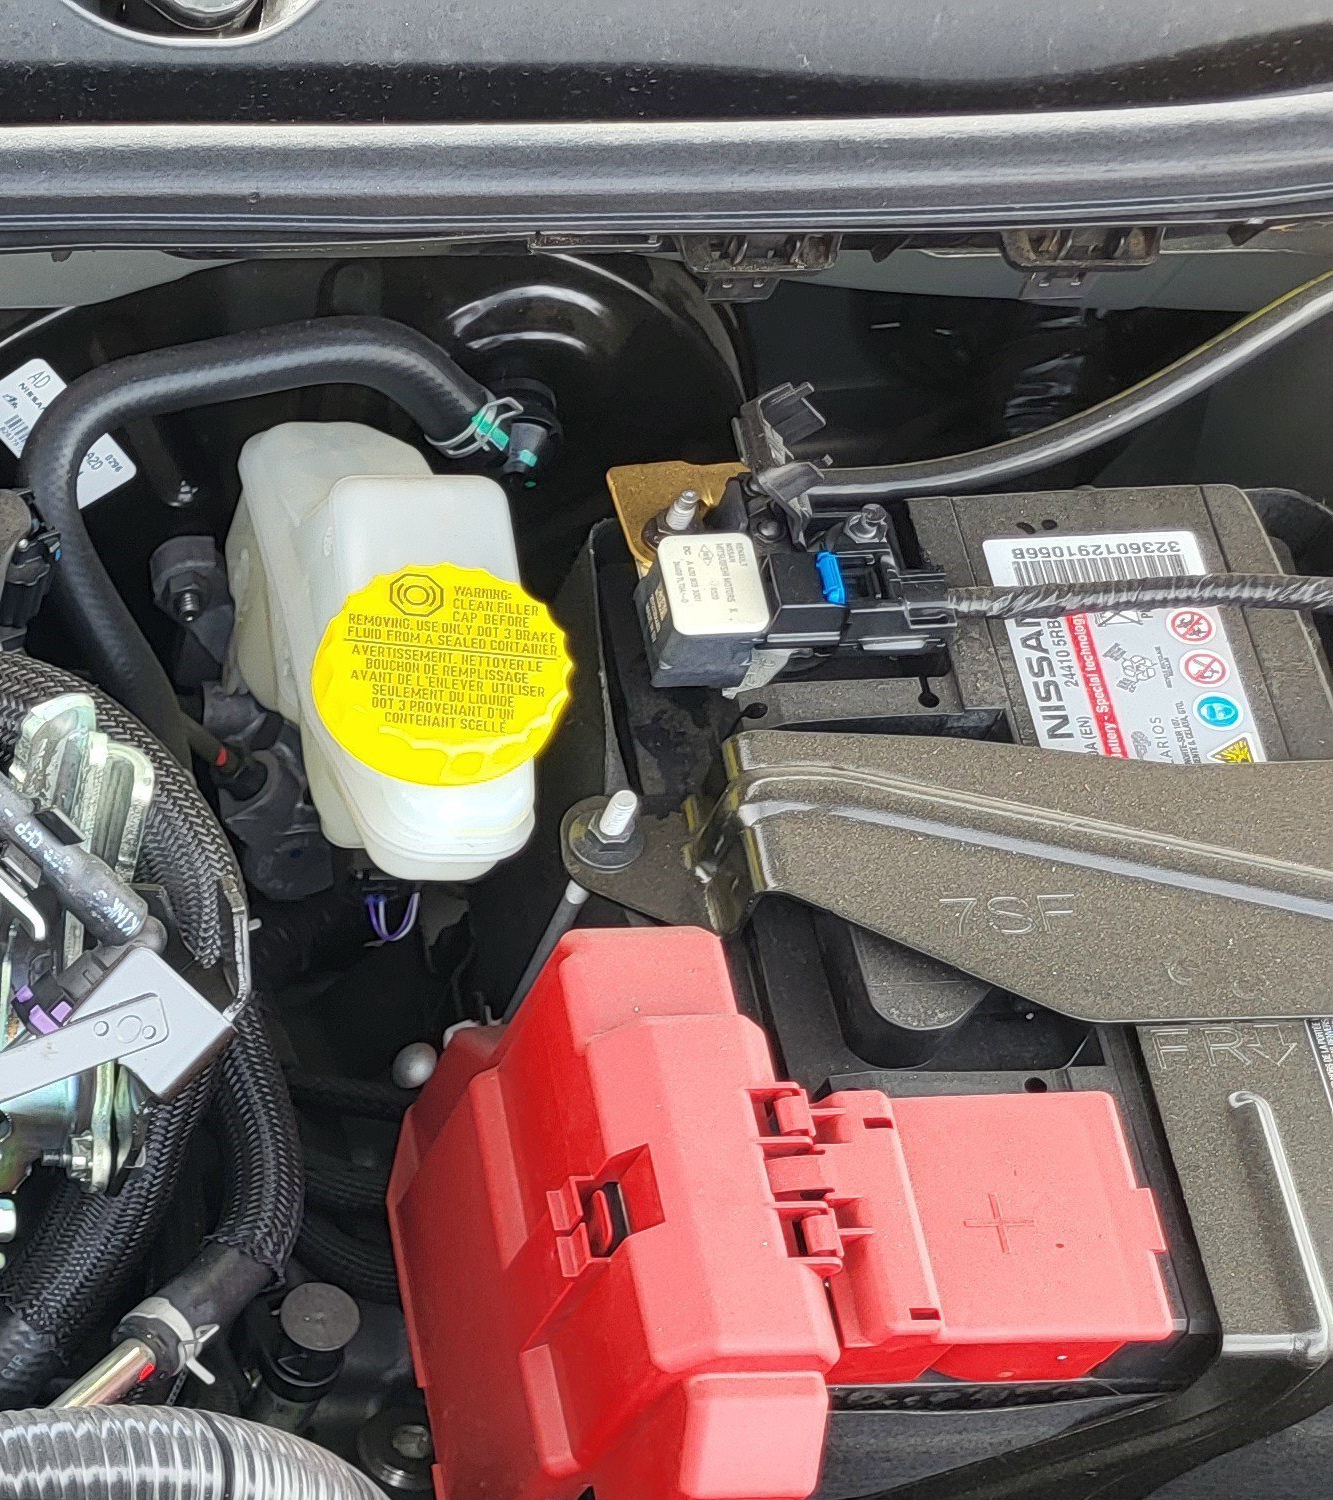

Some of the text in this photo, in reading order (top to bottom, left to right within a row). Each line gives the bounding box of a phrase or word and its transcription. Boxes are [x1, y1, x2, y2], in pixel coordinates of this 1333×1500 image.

[27, 371, 50, 389] AD
[19, 382, 46, 411] NISSA
[454, 586, 512, 600] WARNING:
[453, 598, 538, 616] CLEAN FILLER
[453, 611, 529, 628] CAP BEFORE
[348, 626, 381, 639] FLUID
[386, 630, 420, 643] FROM
[425, 633, 433, 644] A
[438, 635, 486, 649] SEALED
[417, 620, 437, 632] USE
[441, 623, 472, 636] ONLY
[477, 626, 498, 638] DOT
[504, 628, 511, 639] 3
[515, 630, 556, 643] BRAKE
[366, 658, 529, 684] BOUCHON DE REMPLISSAGE
[461, 653, 523, 671] NETTOYER
[528, 660, 543, 672] LE
[1055, 650, 1080, 688] 24410
[351, 670, 393, 683] AVANT
[397, 673, 412, 685] DE
[491, 682, 545, 697] UTILISER
[1087, 674, 1109, 713] Special
[372, 684, 515, 708] SEULEMENT DU LIQUIDE
[372, 697, 514, 720] DOT 3 PROVENANT D'UN
[384, 712, 456, 728] CONTENANT
[1076, 716, 1097, 739] (EN)
[1150, 717, 1173, 763] ARIOS
[939, 892, 1075, 936] 7SF
